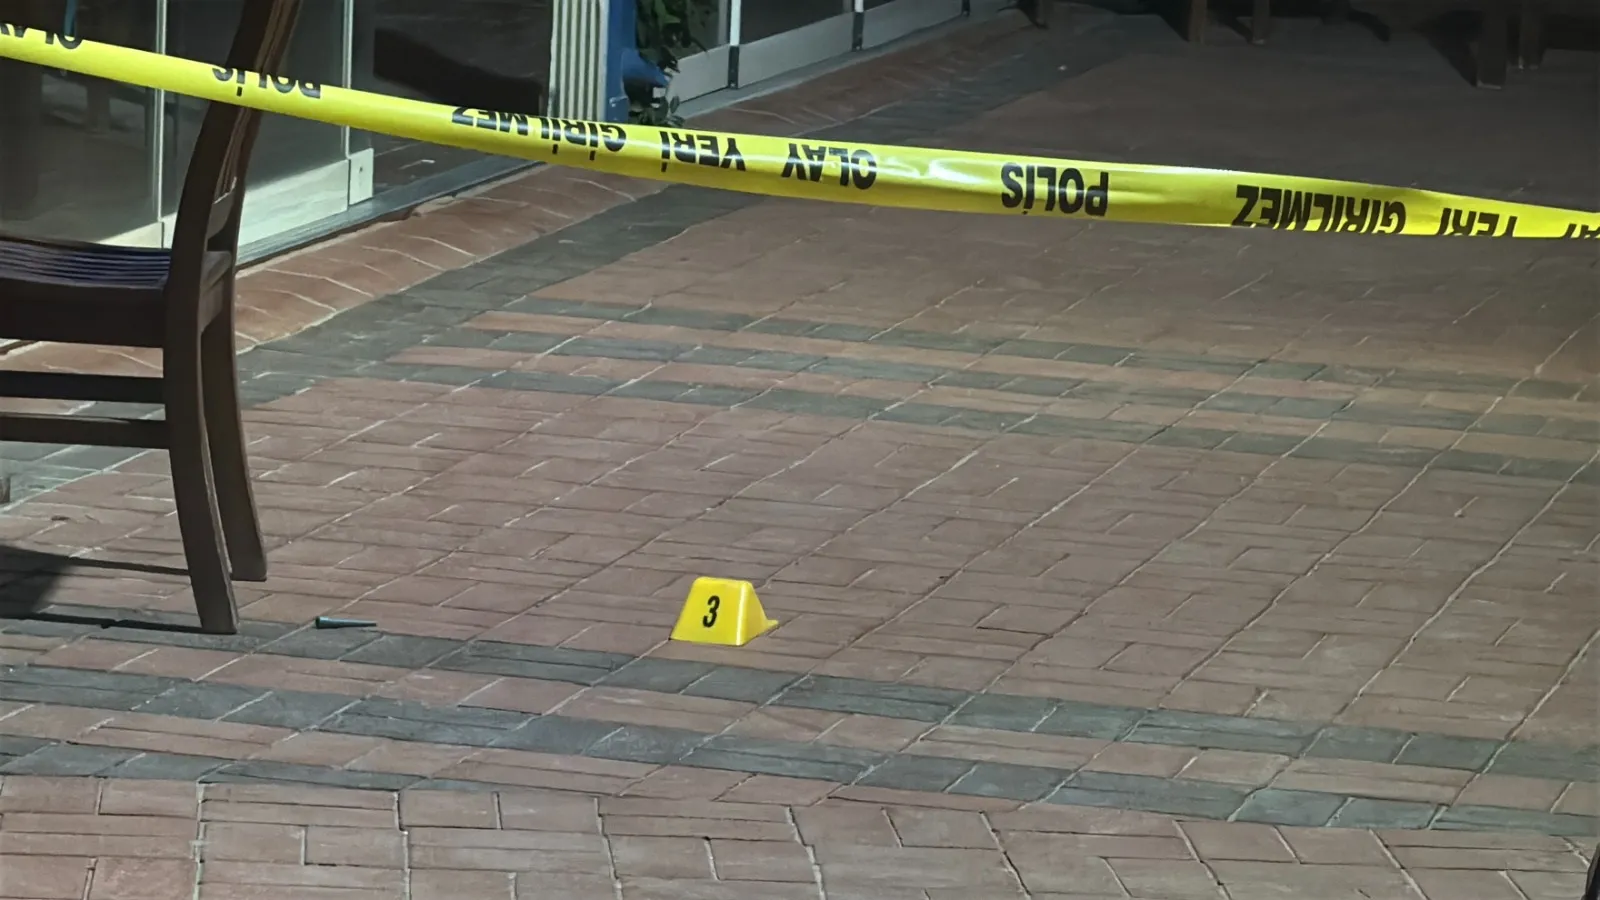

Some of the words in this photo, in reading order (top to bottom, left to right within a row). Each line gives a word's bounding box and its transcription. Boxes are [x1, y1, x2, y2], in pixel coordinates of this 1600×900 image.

[659, 130, 746, 172] YERİ
[781, 142, 877, 190] OLAY
[1000, 162, 1109, 216] POLİS
[702, 595, 720, 628] 3
